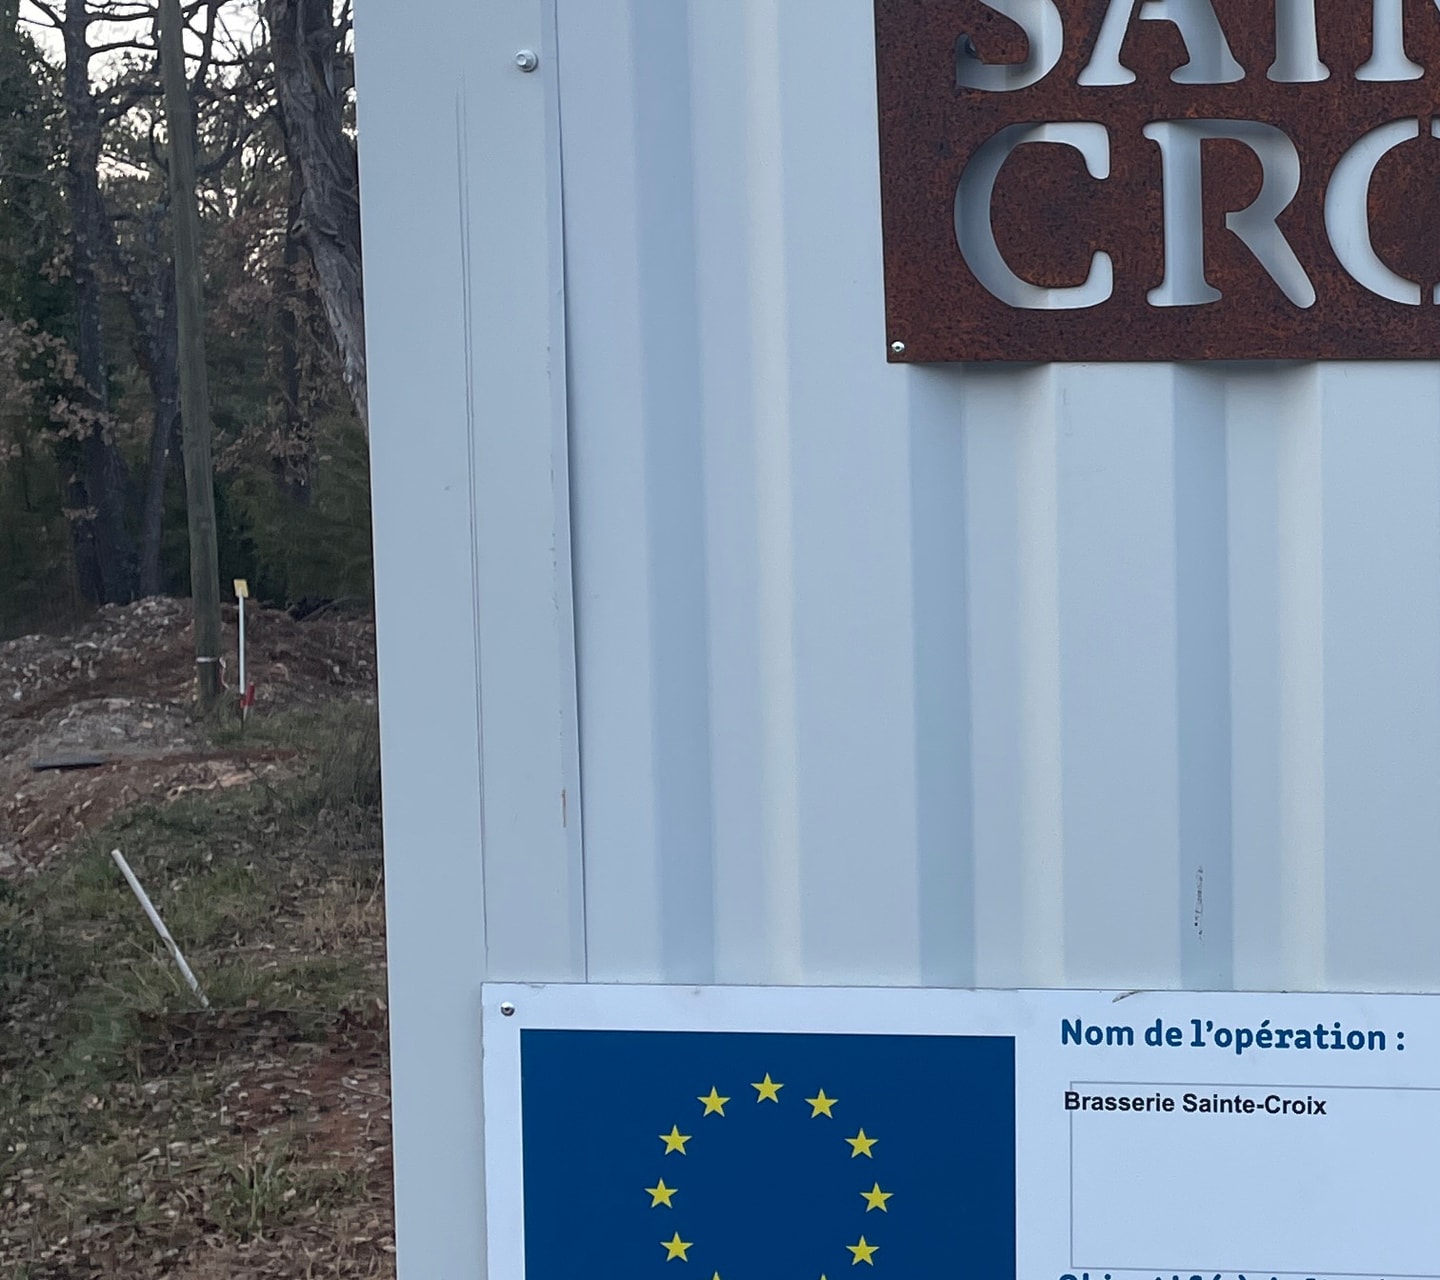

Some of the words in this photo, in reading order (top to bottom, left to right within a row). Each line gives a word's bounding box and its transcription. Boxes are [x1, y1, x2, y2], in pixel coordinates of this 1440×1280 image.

[1062, 1019, 1134, 1046] Nom
[1145, 1018, 1183, 1047] de
[1064, 1091, 1175, 1112] Brasserie
[1182, 1093, 1327, 1115] Sainte-Croix
